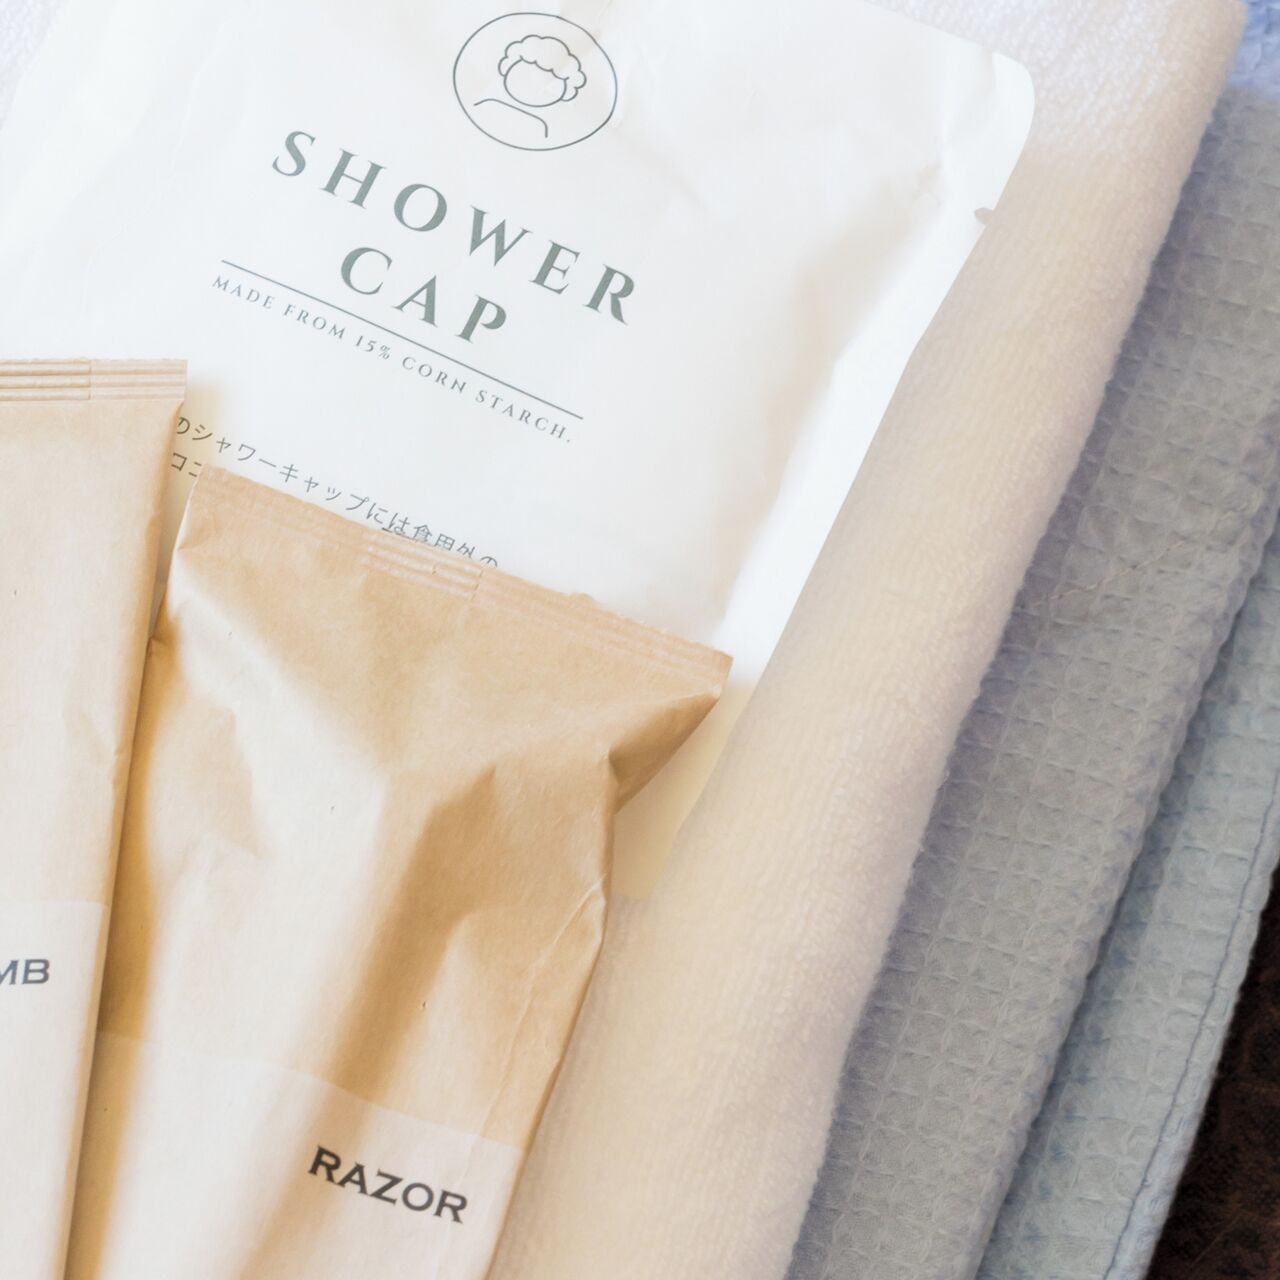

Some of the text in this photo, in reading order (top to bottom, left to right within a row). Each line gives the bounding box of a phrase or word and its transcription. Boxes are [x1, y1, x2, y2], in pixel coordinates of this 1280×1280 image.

[271, 130, 637, 325] SHOWER
[211, 275, 573, 444] MADE FROM 15% CORN STARCH.
[339, 246, 508, 343] CAP
[307, 1144, 468, 1225] RAZOR
